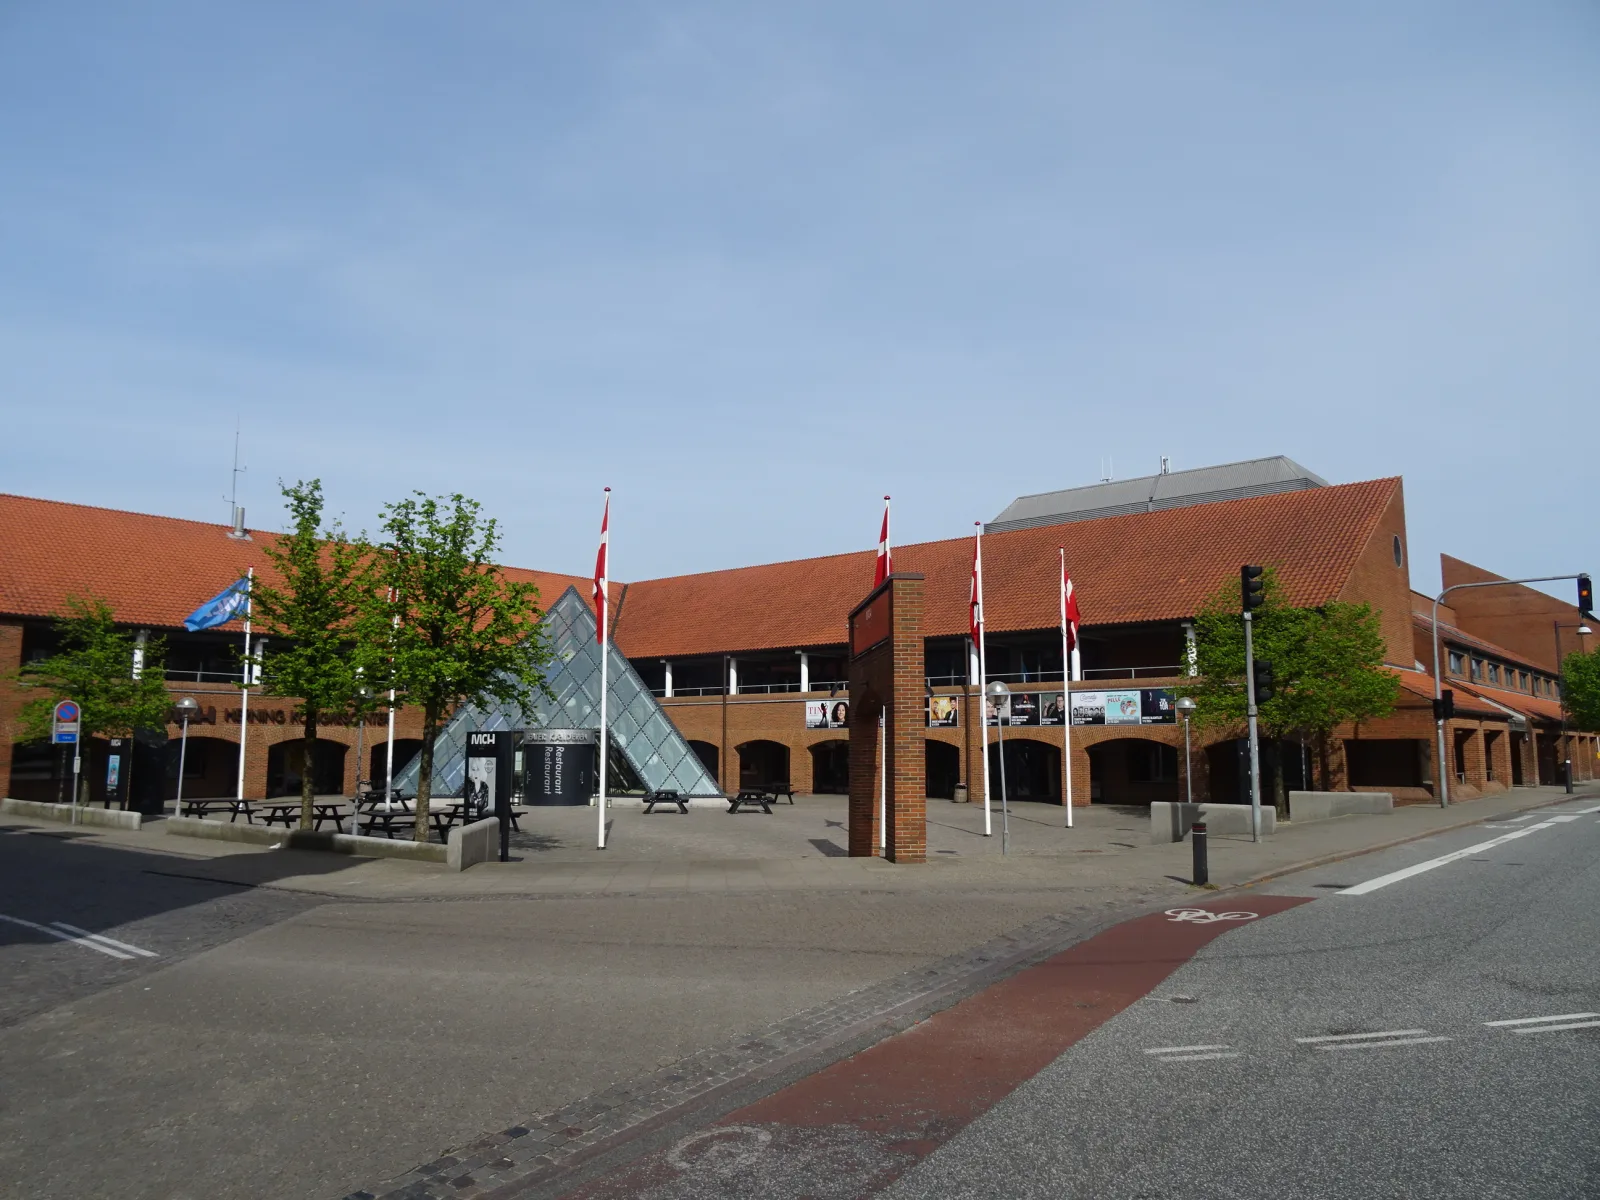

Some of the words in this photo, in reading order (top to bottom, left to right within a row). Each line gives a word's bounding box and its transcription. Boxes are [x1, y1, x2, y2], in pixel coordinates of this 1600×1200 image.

[224, 708, 286, 725] HENING
[471, 734, 496, 745] MCH
[544, 746, 554, 795] Restaurant
[554, 746, 565, 795] Restaurant
